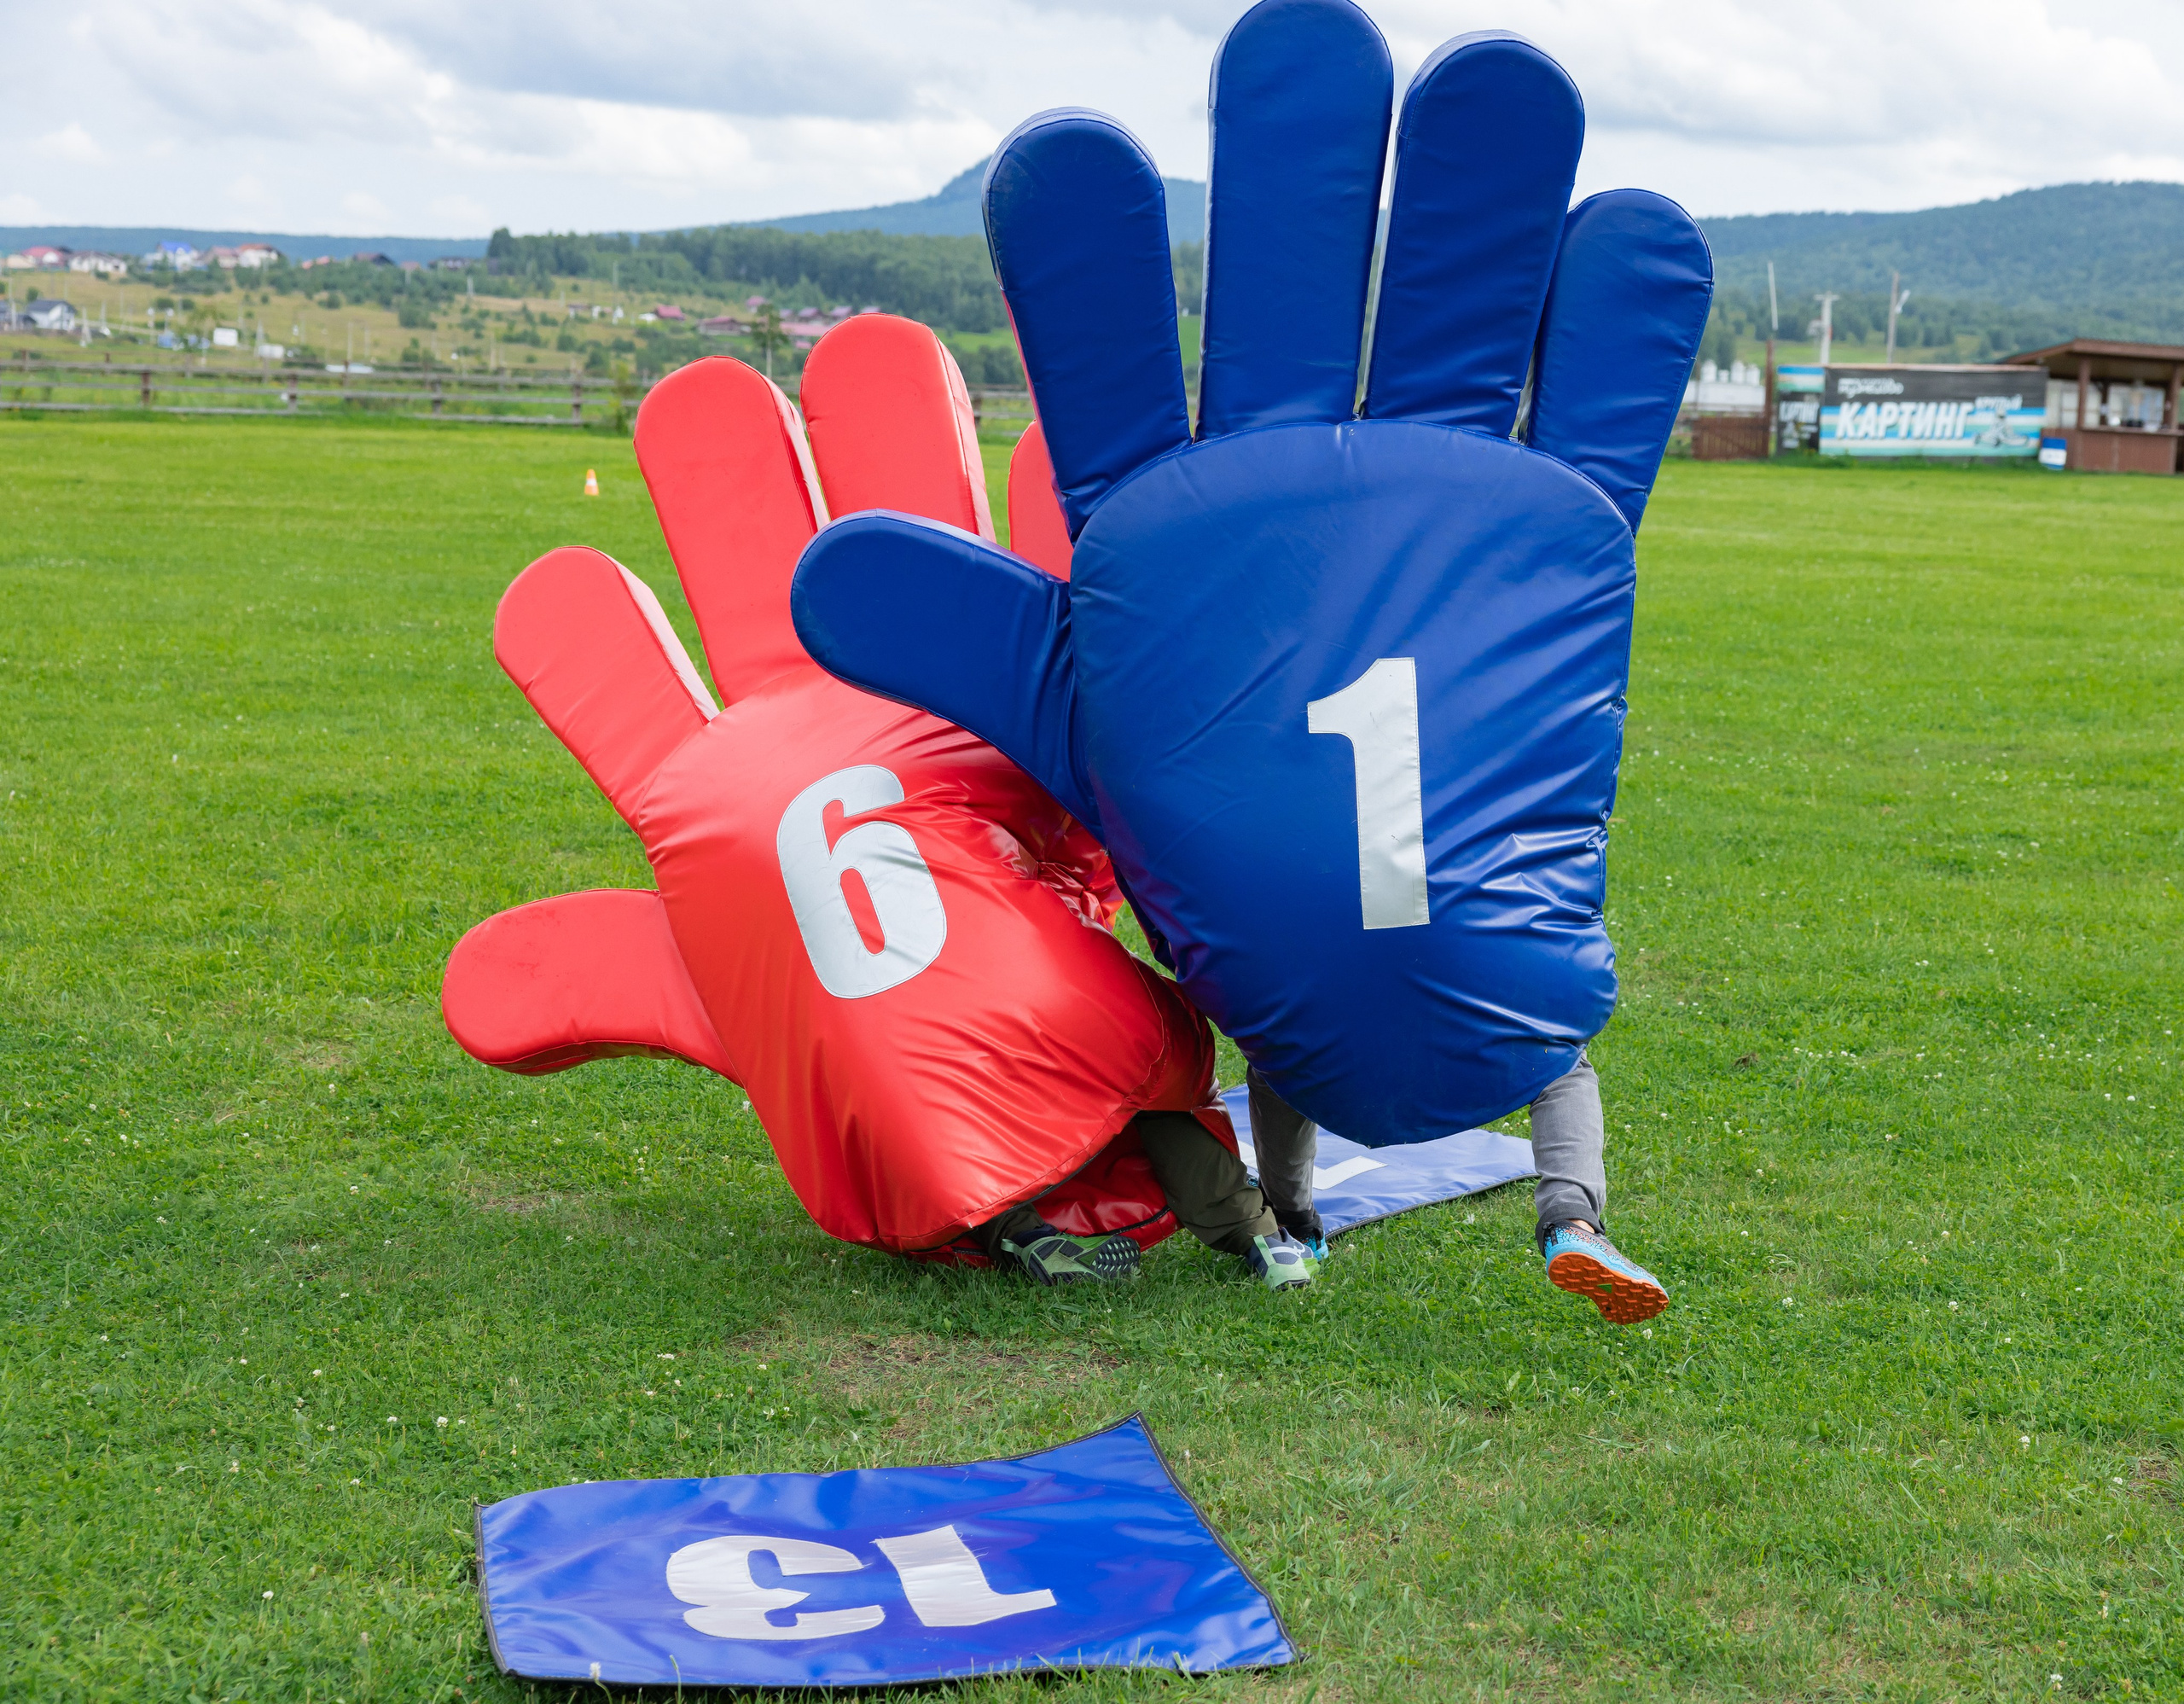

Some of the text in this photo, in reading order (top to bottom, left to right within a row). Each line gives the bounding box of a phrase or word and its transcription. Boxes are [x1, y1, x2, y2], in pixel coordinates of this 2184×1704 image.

[1836, 402, 1974, 439] КАРТИНГ
[775, 762, 949, 1001] 6
[1306, 656, 1431, 930] 1
[666, 1524, 1056, 1641] 13
